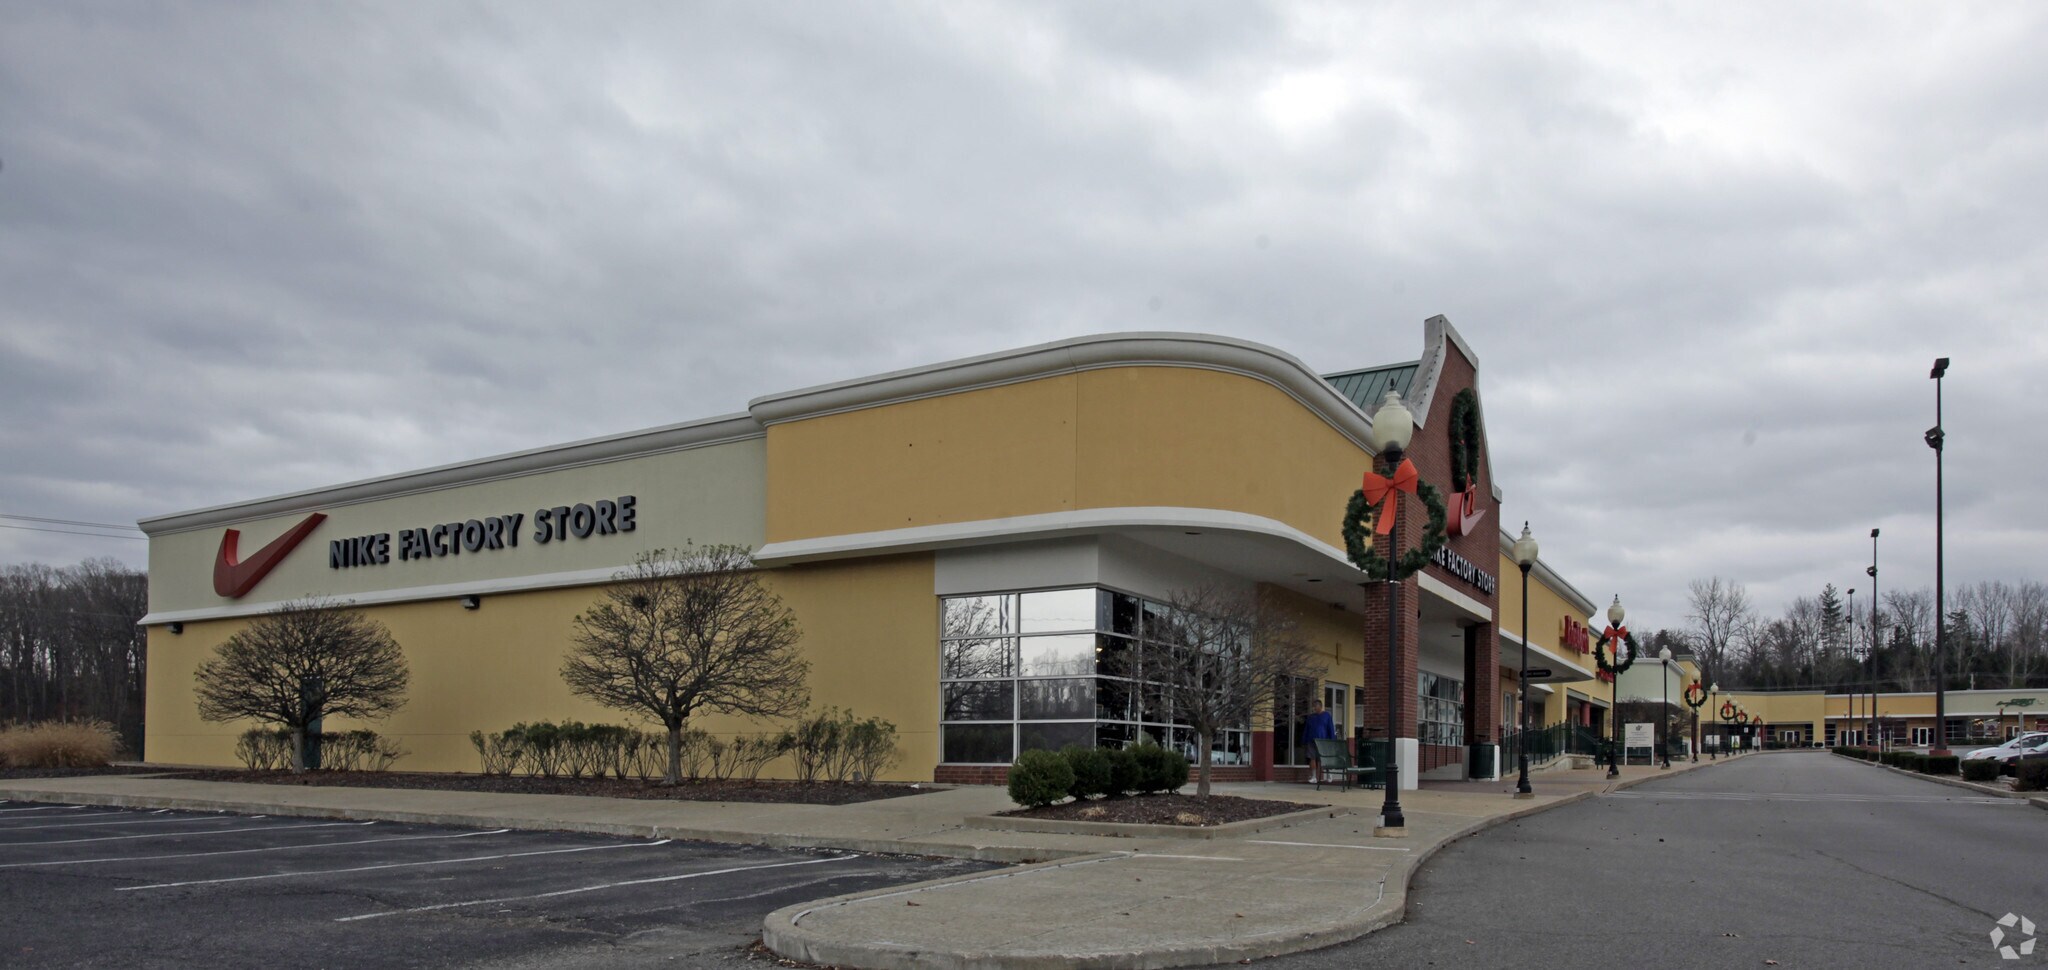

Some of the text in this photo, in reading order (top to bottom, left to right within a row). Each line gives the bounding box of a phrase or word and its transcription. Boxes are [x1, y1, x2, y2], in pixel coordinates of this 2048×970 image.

[329, 495, 637, 569] NIKE FACTORY STORE
[1447, 549, 1476, 584] FACTORY
[1477, 568, 1495, 595] STORE
